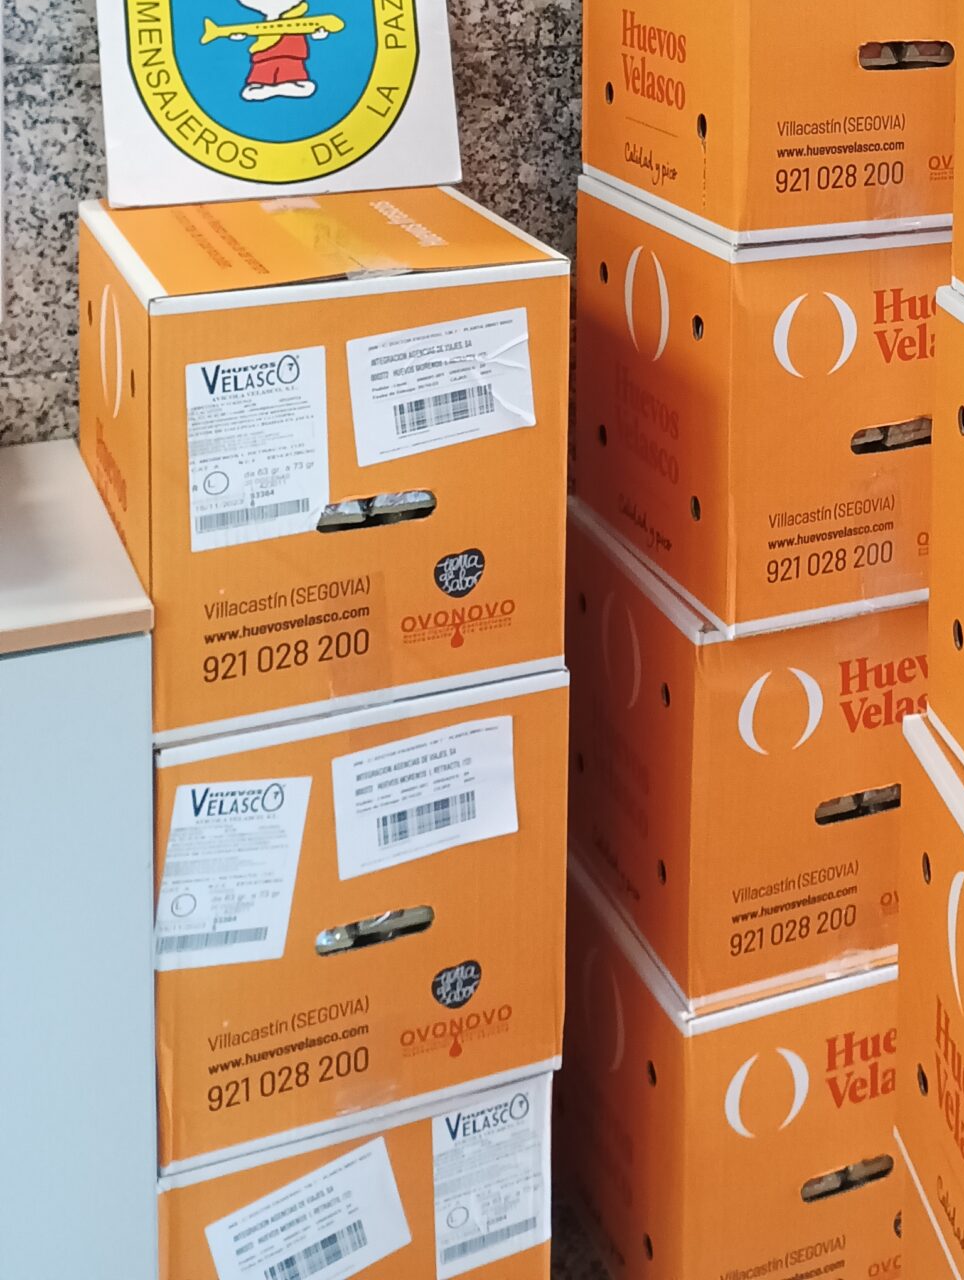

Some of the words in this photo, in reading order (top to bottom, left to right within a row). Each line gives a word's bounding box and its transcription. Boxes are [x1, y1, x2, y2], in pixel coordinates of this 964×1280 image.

[622, 9, 687, 64] Huevos
[136, 1, 258, 169] MENSAJEROS
[311, 132, 354, 166] DE
[366, 85, 399, 118] LA
[621, 53, 686, 110] Velasco
[777, 117, 841, 137] Villacastín
[844, 114, 906, 134] (SEGOVIA)
[777, 140, 905, 159] www.huevosvelasco.com
[775, 167, 811, 193] 921
[816, 165, 857, 190] 028
[864, 161, 904, 187] 200
[201, 354, 300, 395] VELASCO
[768, 506, 831, 529] Villacastín
[833, 494, 896, 519] (SEGOVIA)
[768, 520, 894, 550] www.huevosvelasco.com
[767, 554, 801, 584] 921
[807, 550, 847, 578] 028
[853, 540, 893, 569] 200
[204, 591, 288, 621] Villacastín
[291, 575, 371, 606] (SEGOVIA)
[401, 599, 516, 633] OVONOVO
[204, 606, 370, 645] www.huevosvelasco.com
[203, 650, 248, 683] 921
[257, 640, 309, 674] 028
[318, 629, 370, 662] 200
[191, 783, 285, 817] VELASCO
[732, 878, 796, 904] Villacastín
[797, 860, 860, 889] (SEGOVIA)
[731, 884, 858, 925] www.huevosvelasco.com
[729, 928, 764, 957] 921
[770, 917, 810, 946] 028
[816, 904, 857, 934] 200
[207, 1023, 288, 1052] Villacastín
[291, 995, 370, 1032] (SEGOVIA)
[400, 1005, 513, 1047] OVONOVO
[207, 1024, 369, 1075] www.huevosvelasco.com
[206, 1078, 250, 1112] 921
[260, 1062, 310, 1097] 028
[319, 1047, 369, 1083] 200
[445, 1092, 530, 1141] VELASCO
[784, 1235, 846, 1269] (SEGOVIA)
